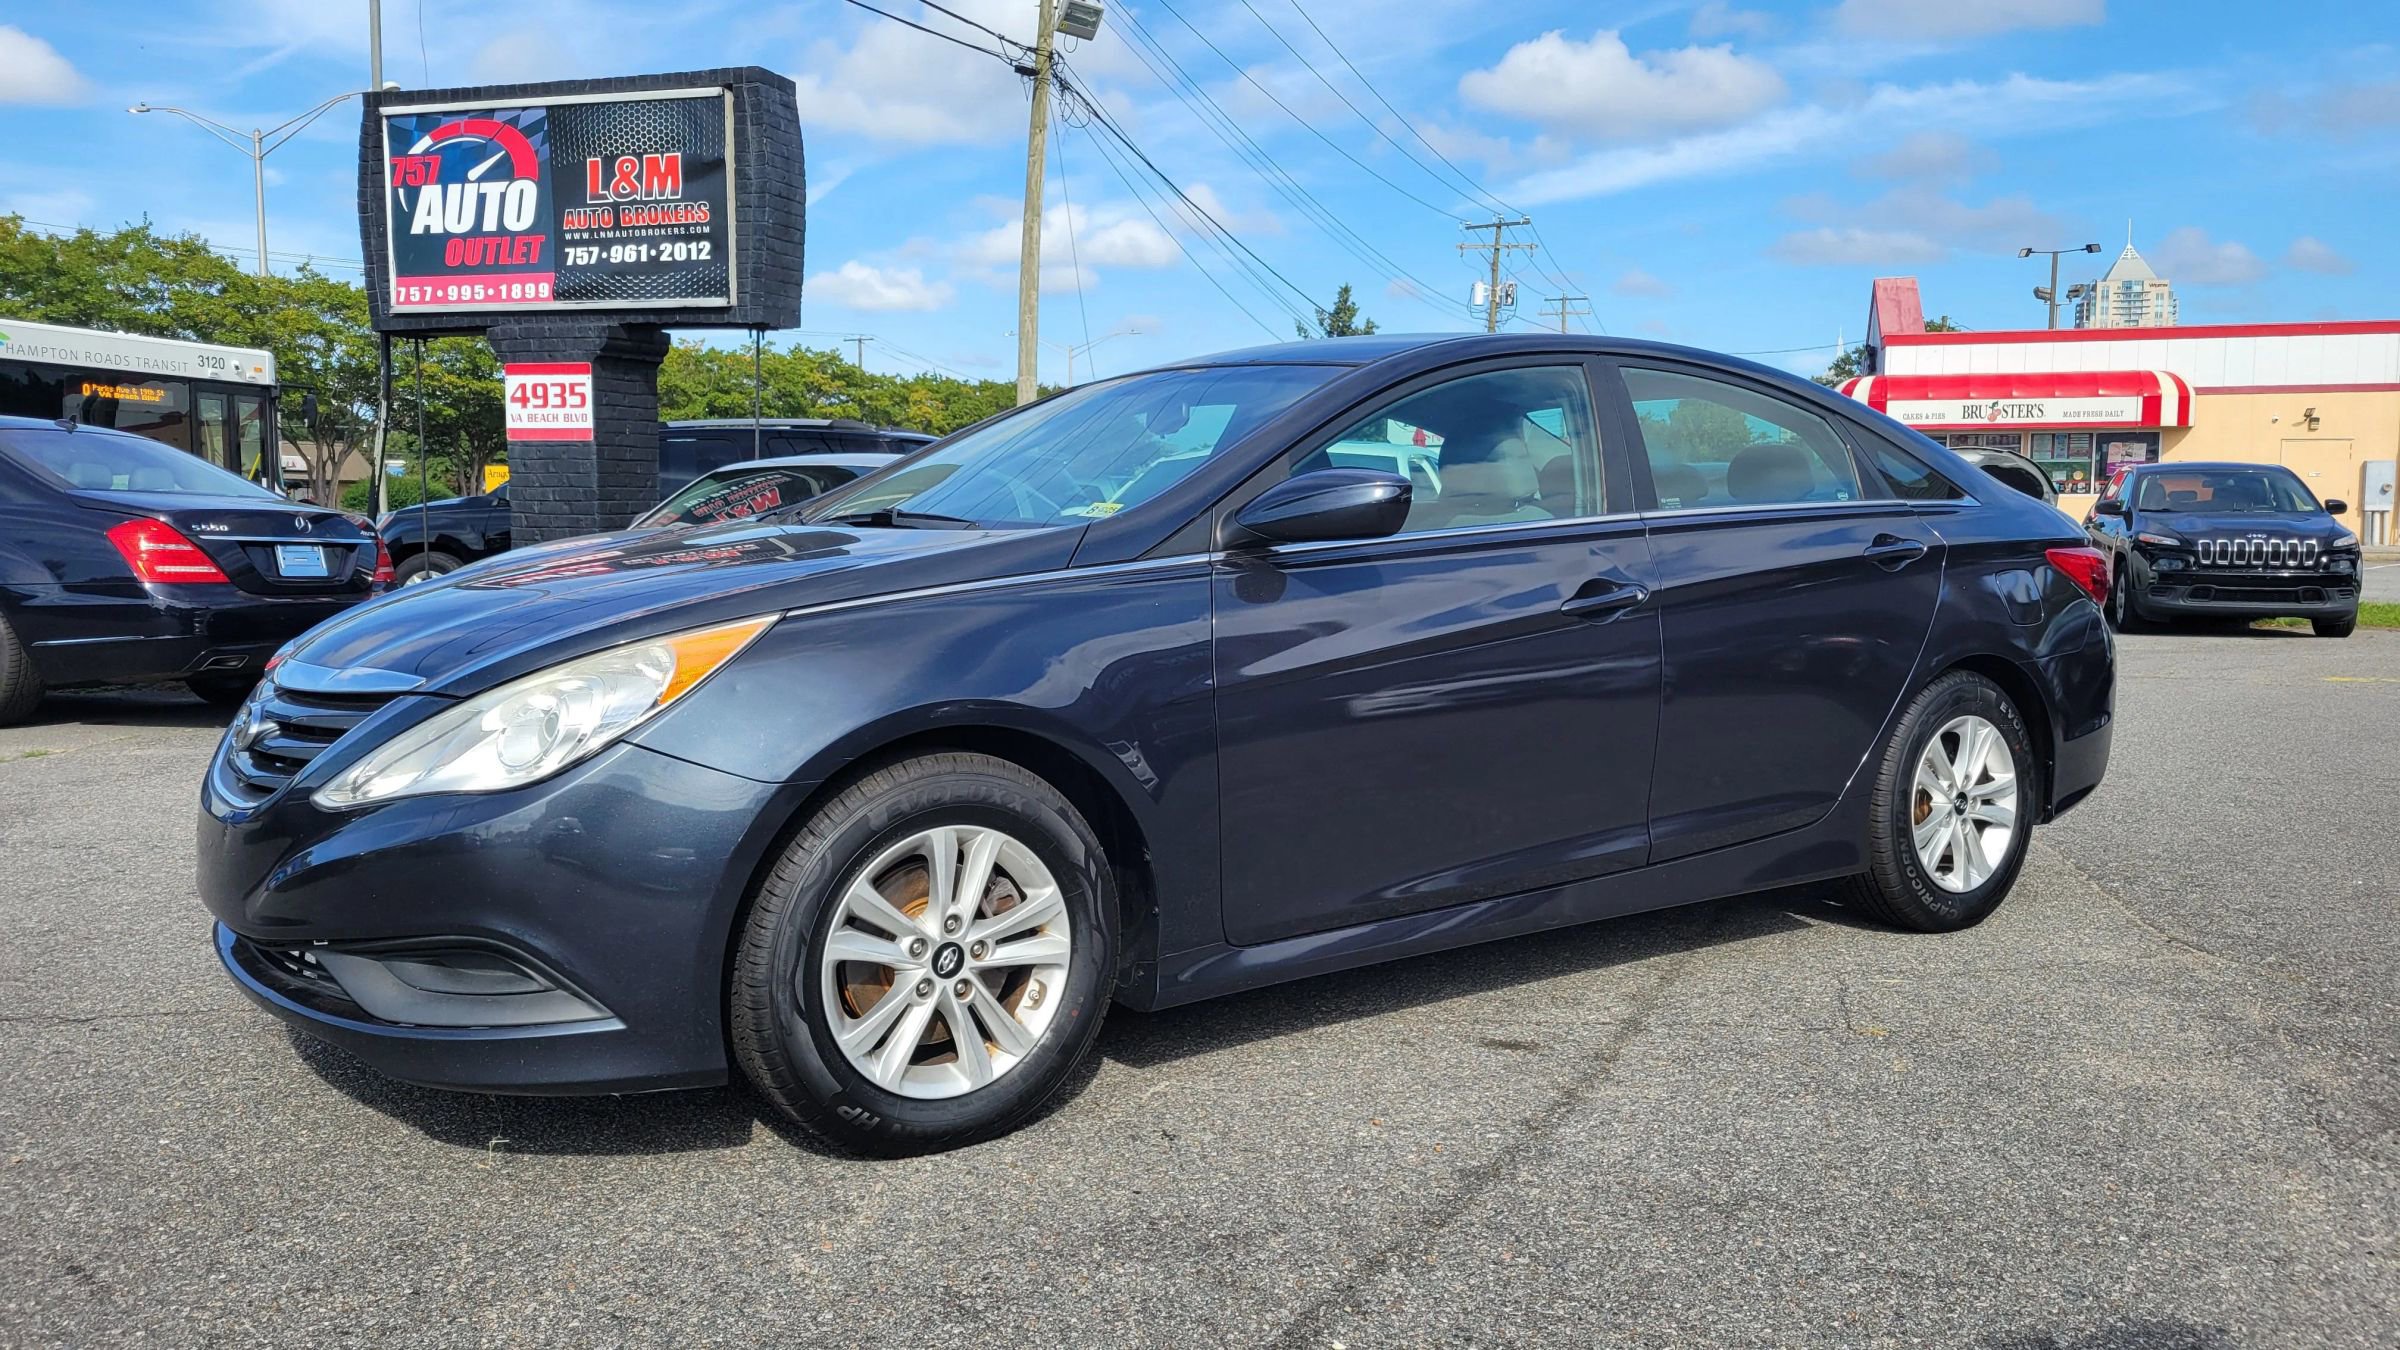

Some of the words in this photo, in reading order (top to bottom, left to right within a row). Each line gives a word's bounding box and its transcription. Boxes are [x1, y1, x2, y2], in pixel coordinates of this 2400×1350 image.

[390, 155, 441, 187] 757
[587, 153, 682, 203] L&M
[410, 180, 537, 234] AUTO
[563, 207, 613, 229] AUTO
[620, 201, 710, 227] BROKERS
[565, 226, 710, 240] WWW.LNMAUTOBROKERS.COM
[445, 235, 545, 267] OUTLET
[5, 343, 79, 360] HAMPTON
[84, 351, 130, 367] ROADS
[136, 356, 188, 372] TRANSIT
[198, 355, 225, 369] 3120
[114, 392, 139, 400] Beach
[510, 383, 587, 409] 4935
[511, 413, 523, 423] VA
[527, 413, 559, 423] BEACH
[563, 413, 588, 423] BLVD
[1903, 412, 1923, 420] CAKES
[1932, 412, 1946, 420] PIES
[2062, 410, 2081, 418] MADE
[2082, 410, 2103, 418] FRESH
[2104, 410, 2124, 418] DAILY
[837, 1105, 880, 1131] HP
